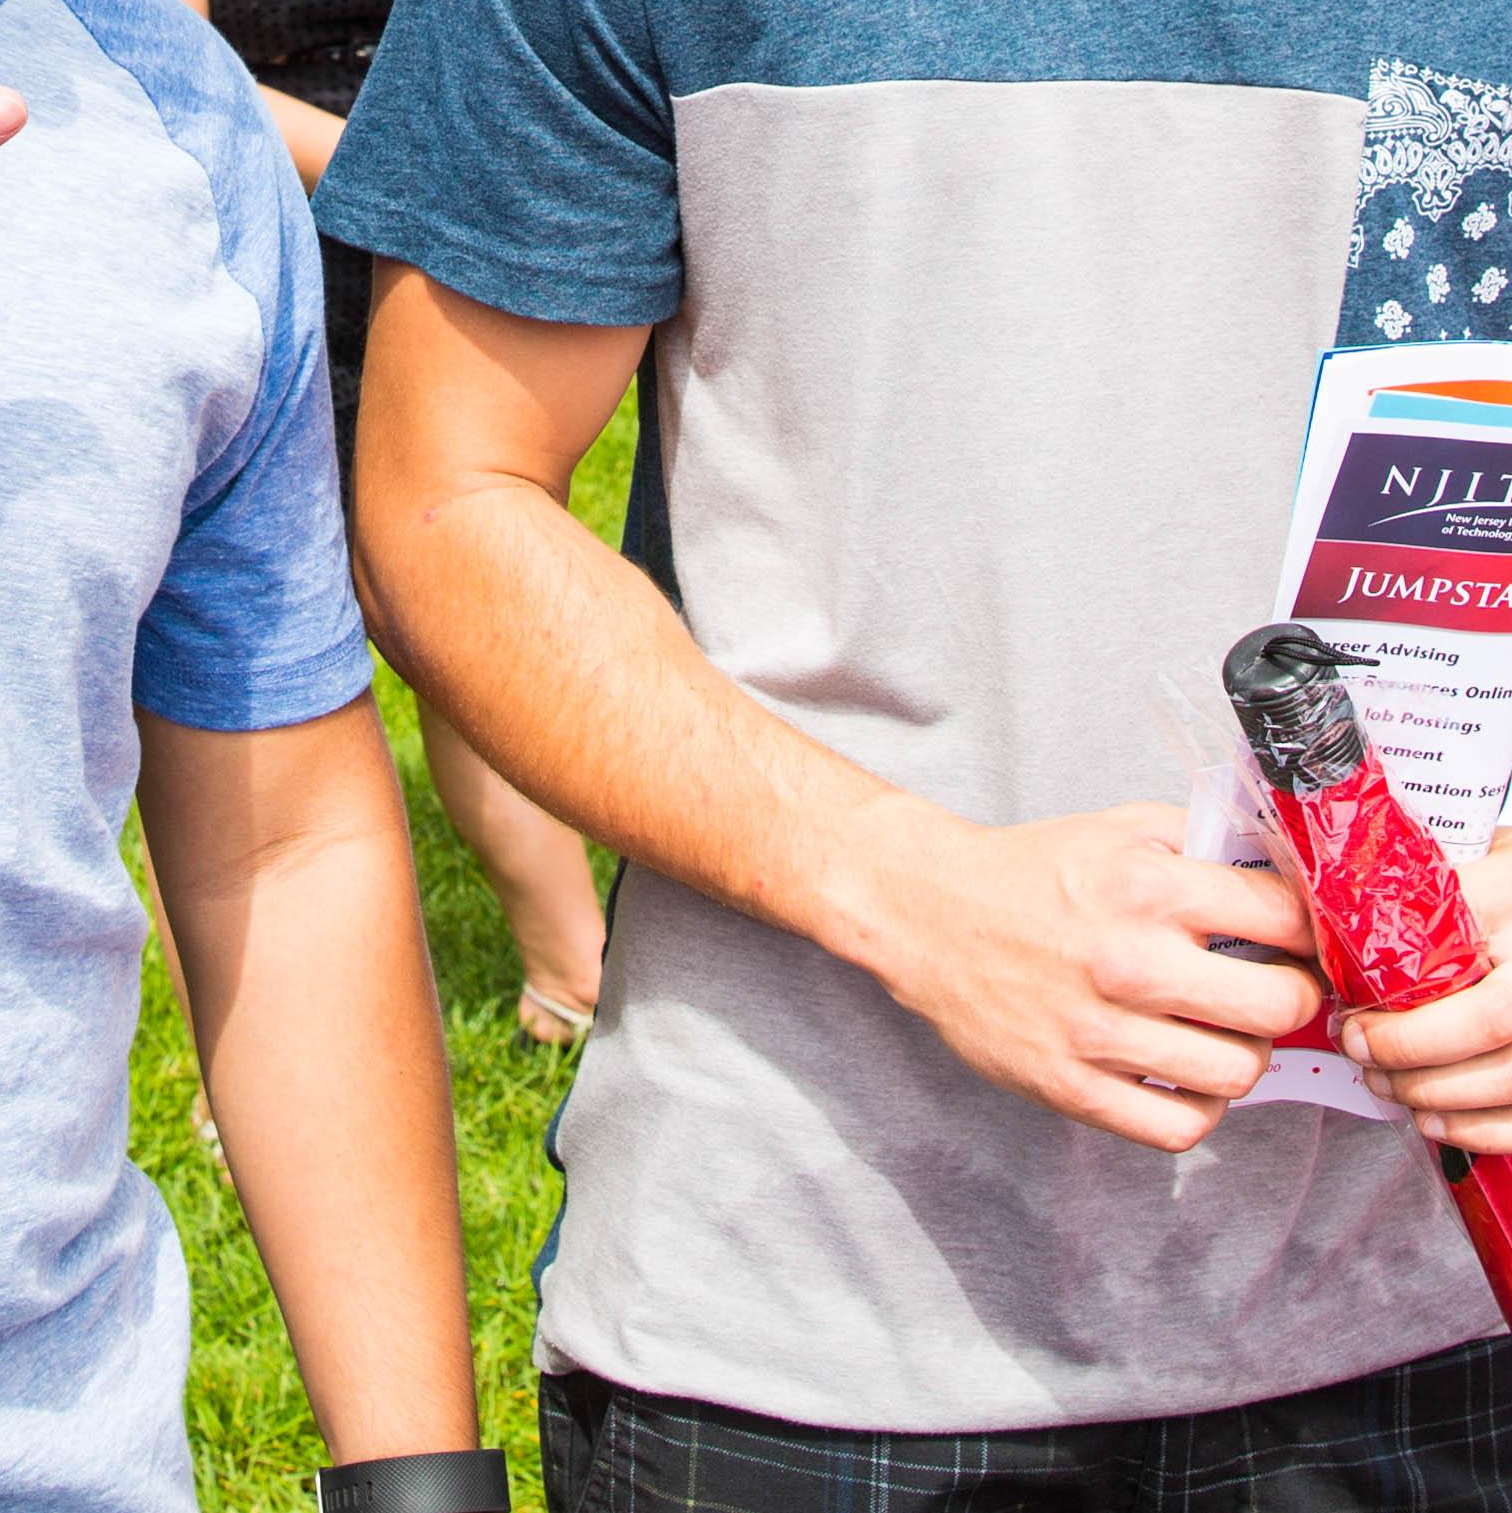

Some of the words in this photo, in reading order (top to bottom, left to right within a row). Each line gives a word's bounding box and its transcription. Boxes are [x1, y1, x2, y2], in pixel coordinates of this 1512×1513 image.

[1445, 513, 1472, 524] New
[1473, 514, 1507, 527] Jersey
[1441, 524, 1455, 535] of
[1323, 641, 1371, 654] areer
[1375, 641, 1460, 666] Advising
[1400, 711, 1483, 734] Postings
[1400, 780, 1472, 798] mation
